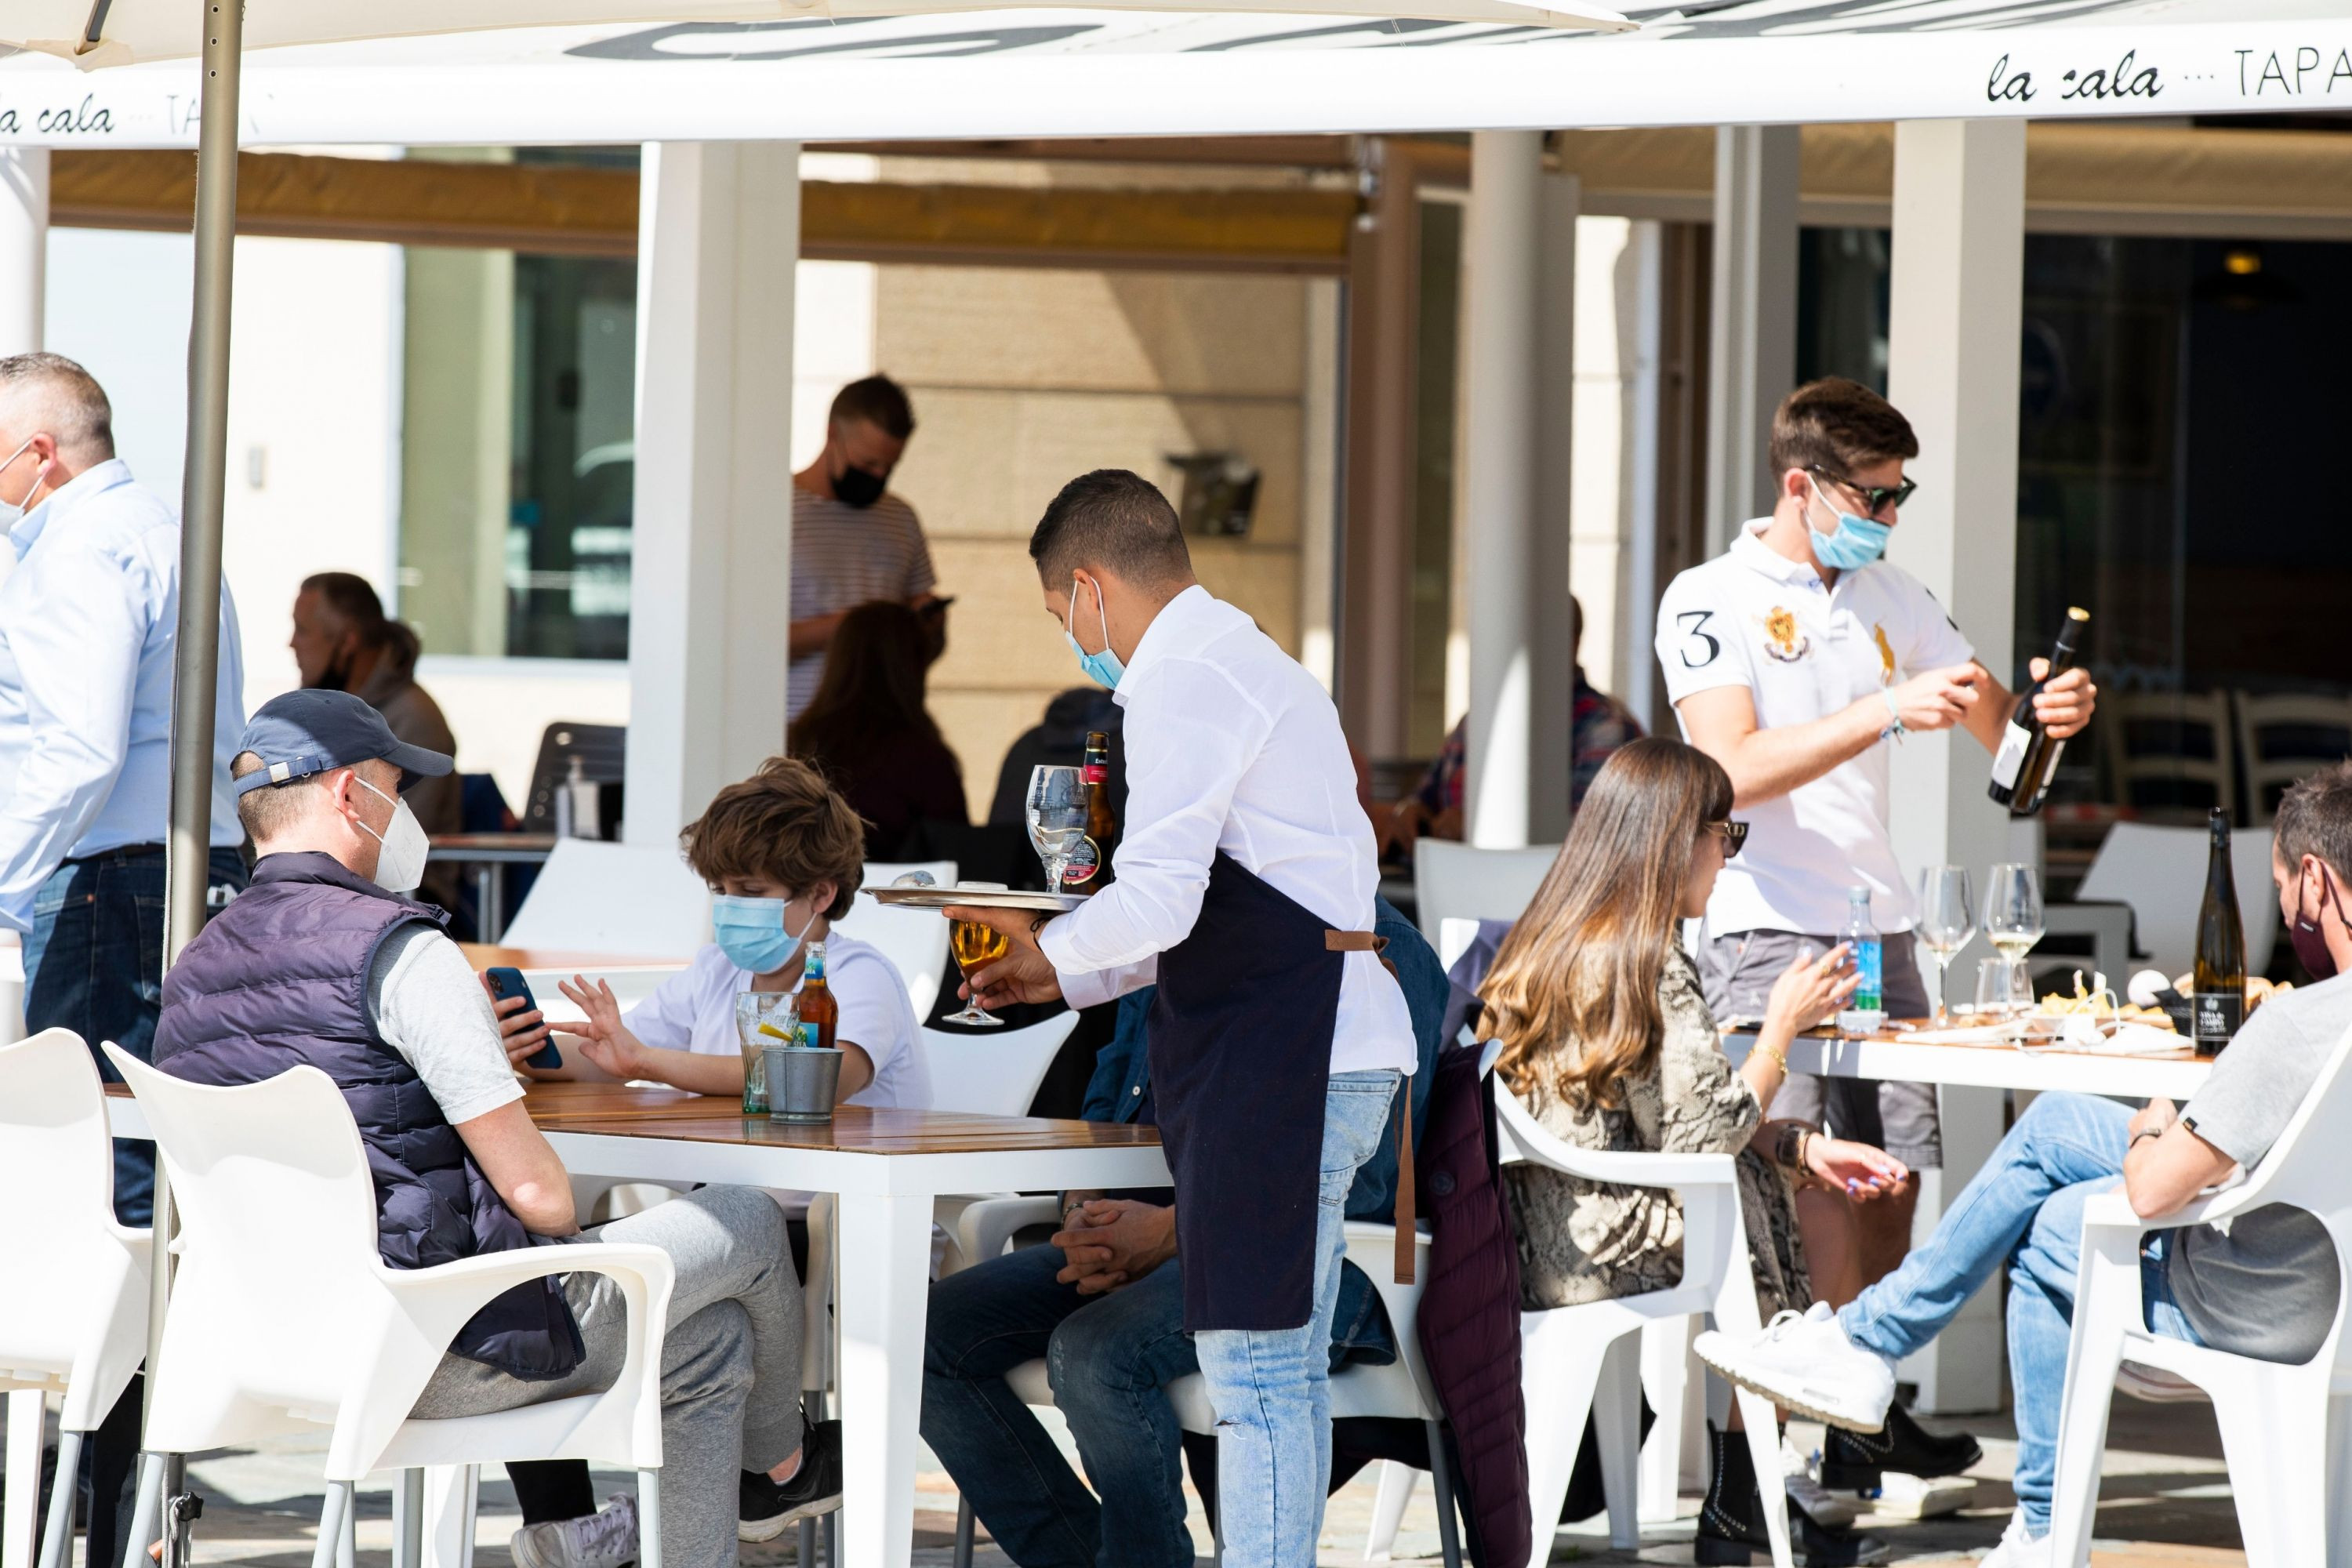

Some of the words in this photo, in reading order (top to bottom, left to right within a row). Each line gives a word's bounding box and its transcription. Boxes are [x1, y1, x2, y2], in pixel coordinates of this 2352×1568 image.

[1987, 53, 2038, 102] la
[0, 92, 22, 135] a
[38, 93, 115, 134] cala
[1676, 610, 1721, 668] 3
